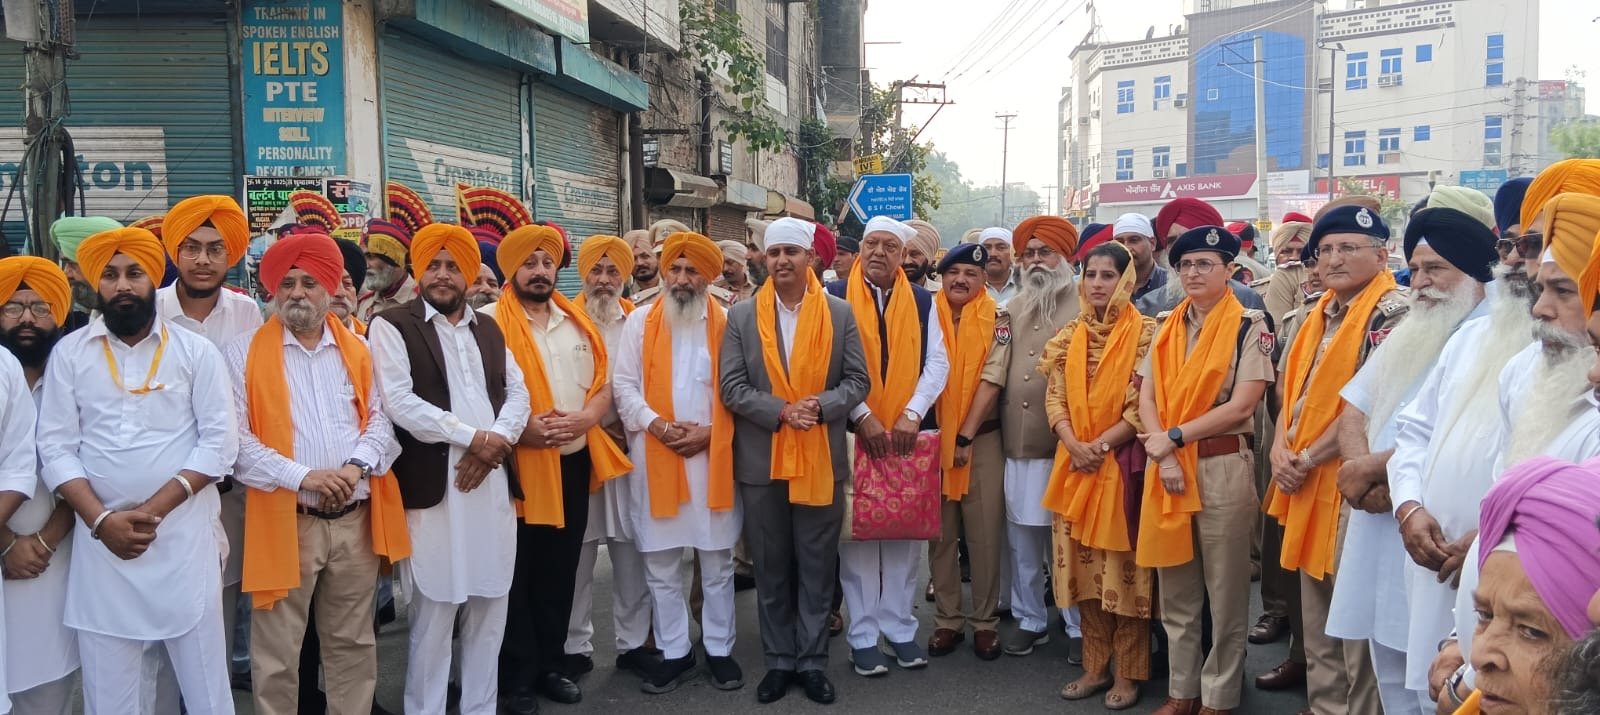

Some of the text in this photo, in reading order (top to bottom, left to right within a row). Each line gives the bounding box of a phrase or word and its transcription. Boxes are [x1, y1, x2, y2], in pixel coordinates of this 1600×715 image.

[254, 7, 326, 20] TRAINING IN
[243, 25, 339, 39] SPOKEN ENGLISH
[253, 42, 330, 76] IELTS
[266, 81, 318, 102] PTE
[263, 107, 325, 122] INTERVIEW
[258, 146, 333, 160] PERSONALITY
[860, 161, 876, 171] IVF
[1176, 181, 1222, 195] AXIS BANK
[1337, 179, 1378, 191] HEL
